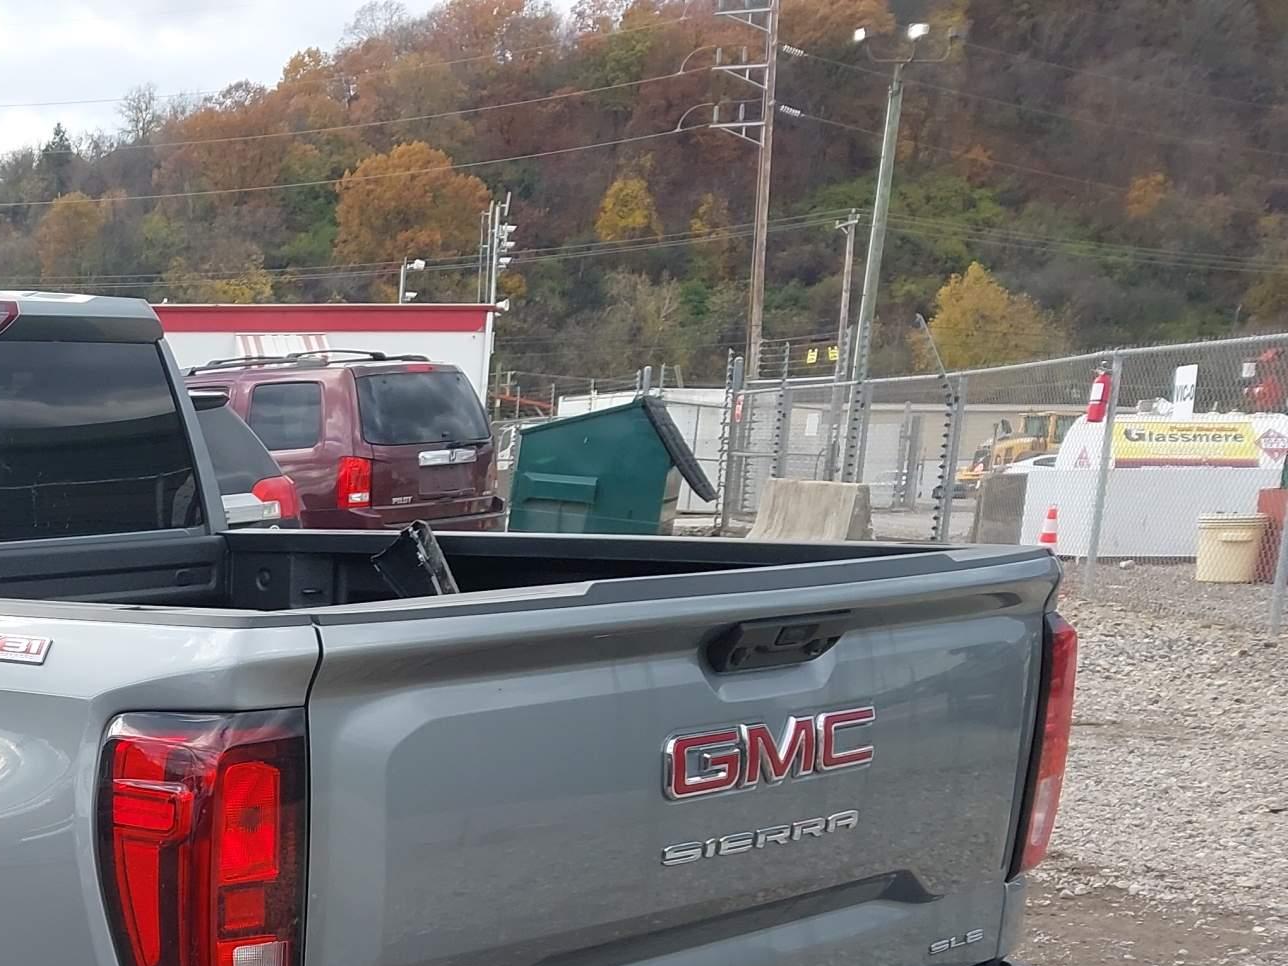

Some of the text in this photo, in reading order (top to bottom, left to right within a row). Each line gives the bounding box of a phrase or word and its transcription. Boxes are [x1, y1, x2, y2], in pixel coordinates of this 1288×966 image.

[1124, 428, 1245, 443] Glassmere
[392, 496, 413, 504] PILOT
[664, 705, 876, 799] GMC
[661, 808, 860, 867] SIERRA
[929, 928, 984, 955] SLE
